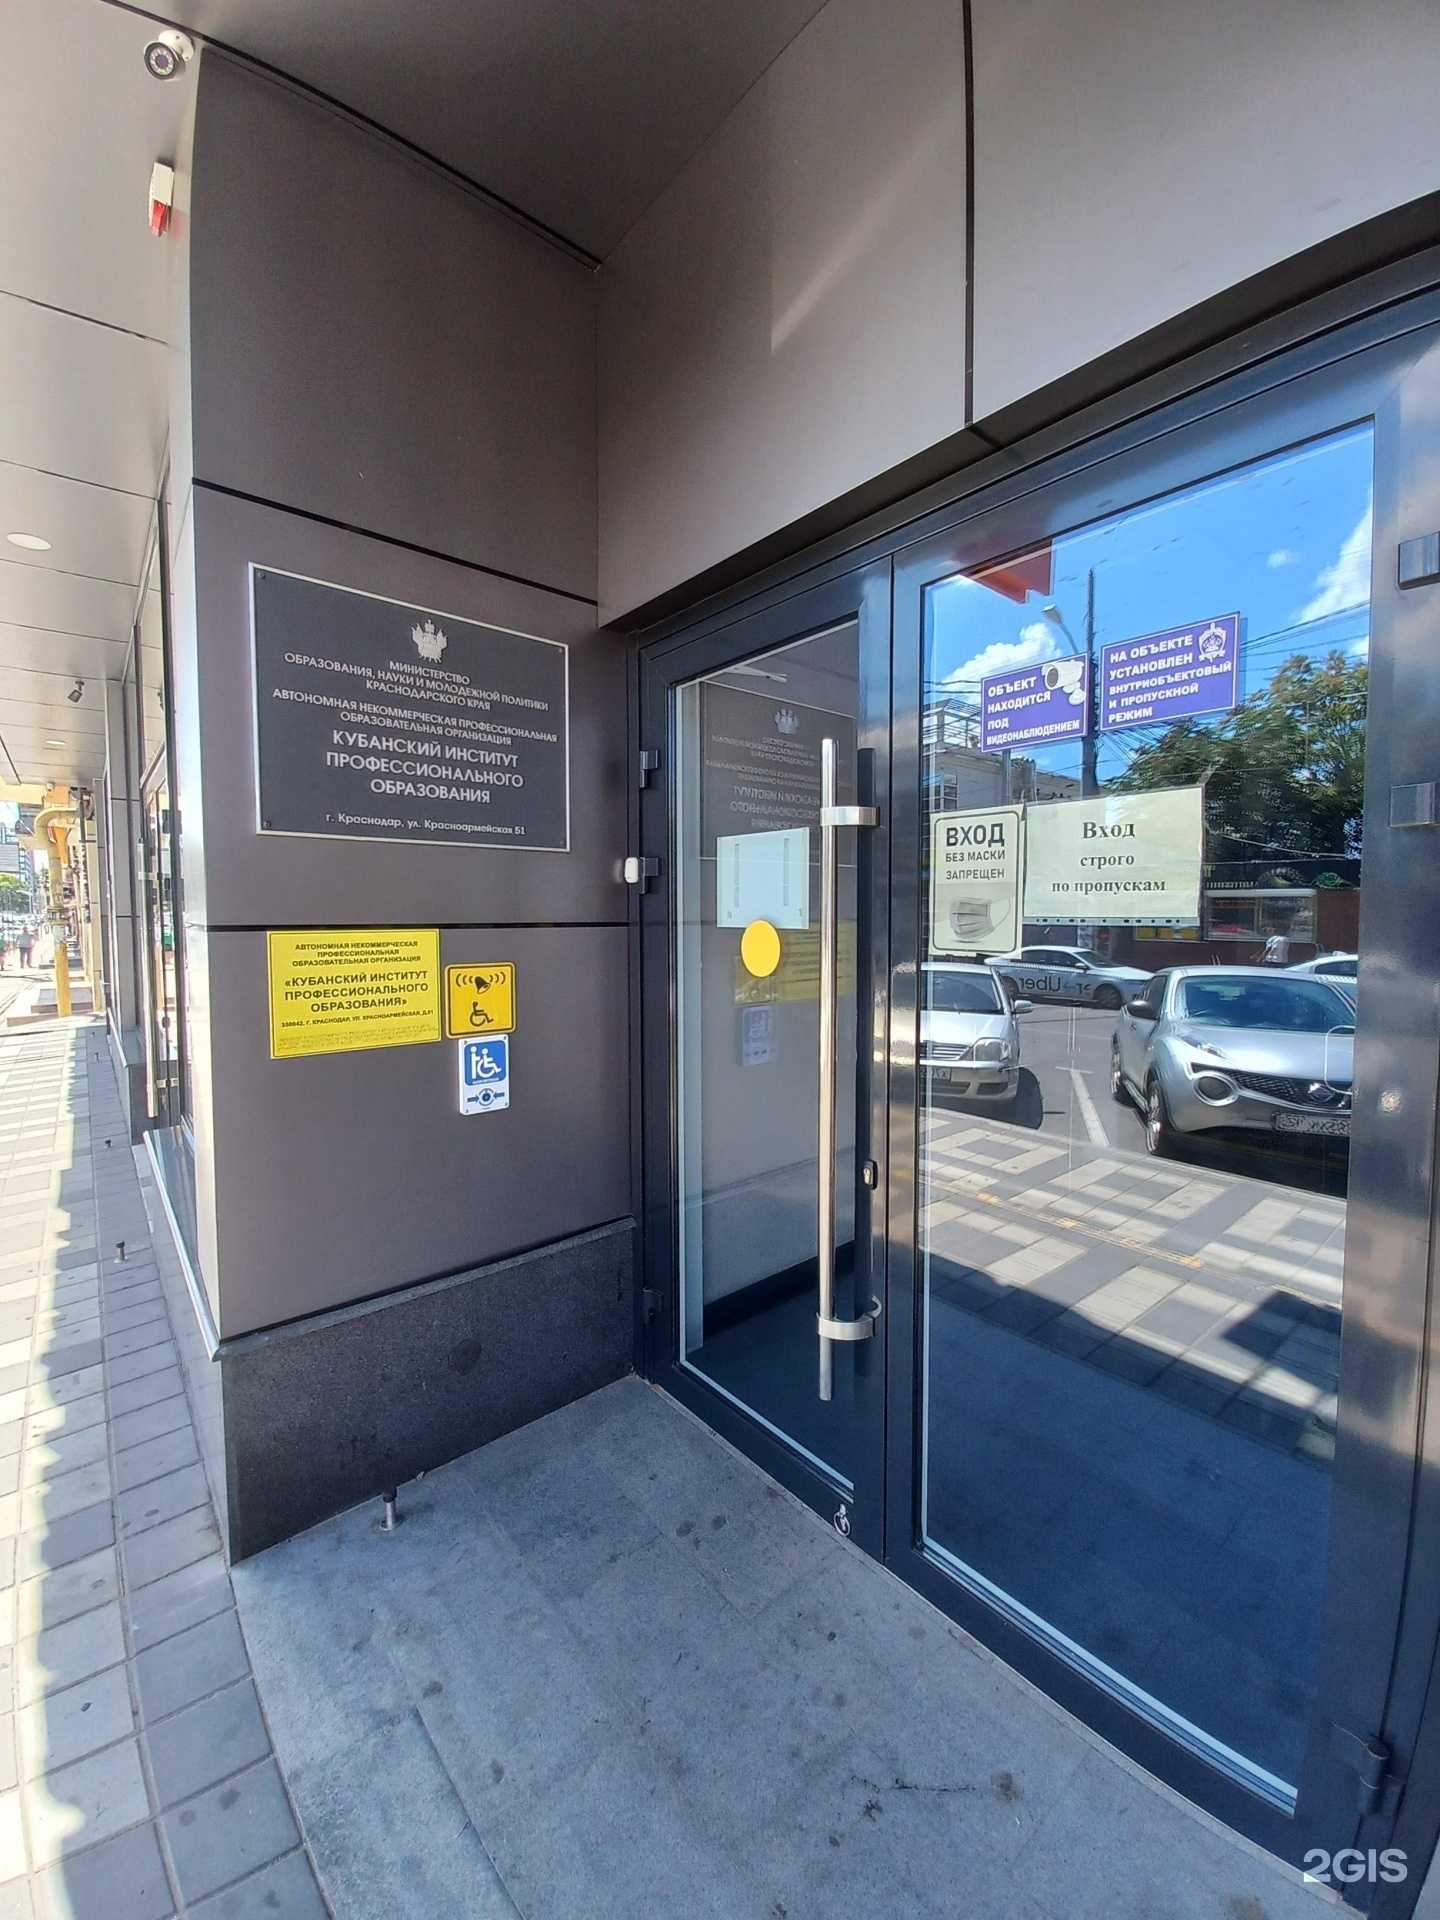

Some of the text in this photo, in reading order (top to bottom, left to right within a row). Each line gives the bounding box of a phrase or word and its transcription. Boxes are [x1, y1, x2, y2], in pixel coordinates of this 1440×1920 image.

[1110, 634, 1193, 664] НА ОБЪЕКТЕ
[389, 660, 470, 685] МИНИСТЕРСТВО
[1109, 653, 1193, 681] УСТАНОВЛЕН
[1109, 661, 1232, 695] ВНУТРИОБЪЕКТОВЫЙ
[284, 652, 549, 711] ОБРАЗОВАНИЯ, НАУКИ И МОЛОДЕЖНОЙ ПОЛИТИКИ
[988, 676, 1036, 698] ОБЪЕКТ
[366, 679, 491, 711] КРАСНОДАРСКОГО КРАЯ
[987, 690, 1051, 714] НАХОДИТСЯ
[1109, 682, 1198, 710] И ПРОПУСКНОЙ
[272, 689, 557, 743] АВТОНОМНАЯ НЕКОММЕРЧЕСКАЯ ПРОФЕССИОНАЛЬНАЯ
[987, 717, 1009, 730] ПОД
[1108, 706, 1152, 724] РЕЖИМ
[340, 711, 512, 746] ОБРАЗОВАТЕЛЬНАЯ ОРГАНИЗАЦИЯ
[986, 719, 1080, 746] ВИДЕОНАБЛЮДЕНИЕМ
[332, 730, 518, 768] КУБАНСКИЙ ИНСТИТУТ
[326, 751, 524, 787] ПРОФЕССИОНАЛЬНОГО
[370, 778, 490, 803] ОБРАЗОВАНИЯ
[326, 813, 526, 835] г. Краснодар, ул. Красноармейская 51
[946, 823, 1005, 847] ВХОД
[1082, 822, 1135, 839] Вход
[945, 849, 1006, 862] БЕЗ МАСКИ
[1080, 854, 1135, 870] строго
[946, 868, 1005, 881] ЗАПРЕЩЕН
[1052, 880, 1166, 895] по пропускам
[295, 940, 418, 951] АВТОНОМНАЯ НЕКОММЕРЧЕСКАЯ
[317, 949, 399, 958] ПРОФЕССИОНАЛЬНАЯ
[292, 955, 421, 967] ОБРАЗОВАТЕЛЬНАЯ ОРГАНИЗАЦИЯ
[285, 970, 428, 987] «КУБАНСКИЙ ИНСТИТУТ
[285, 983, 429, 1001] ПРОФЕССИОНАЛЬНОГО
[311, 997, 408, 1012] ОБРАЗОВАНИЯ»
